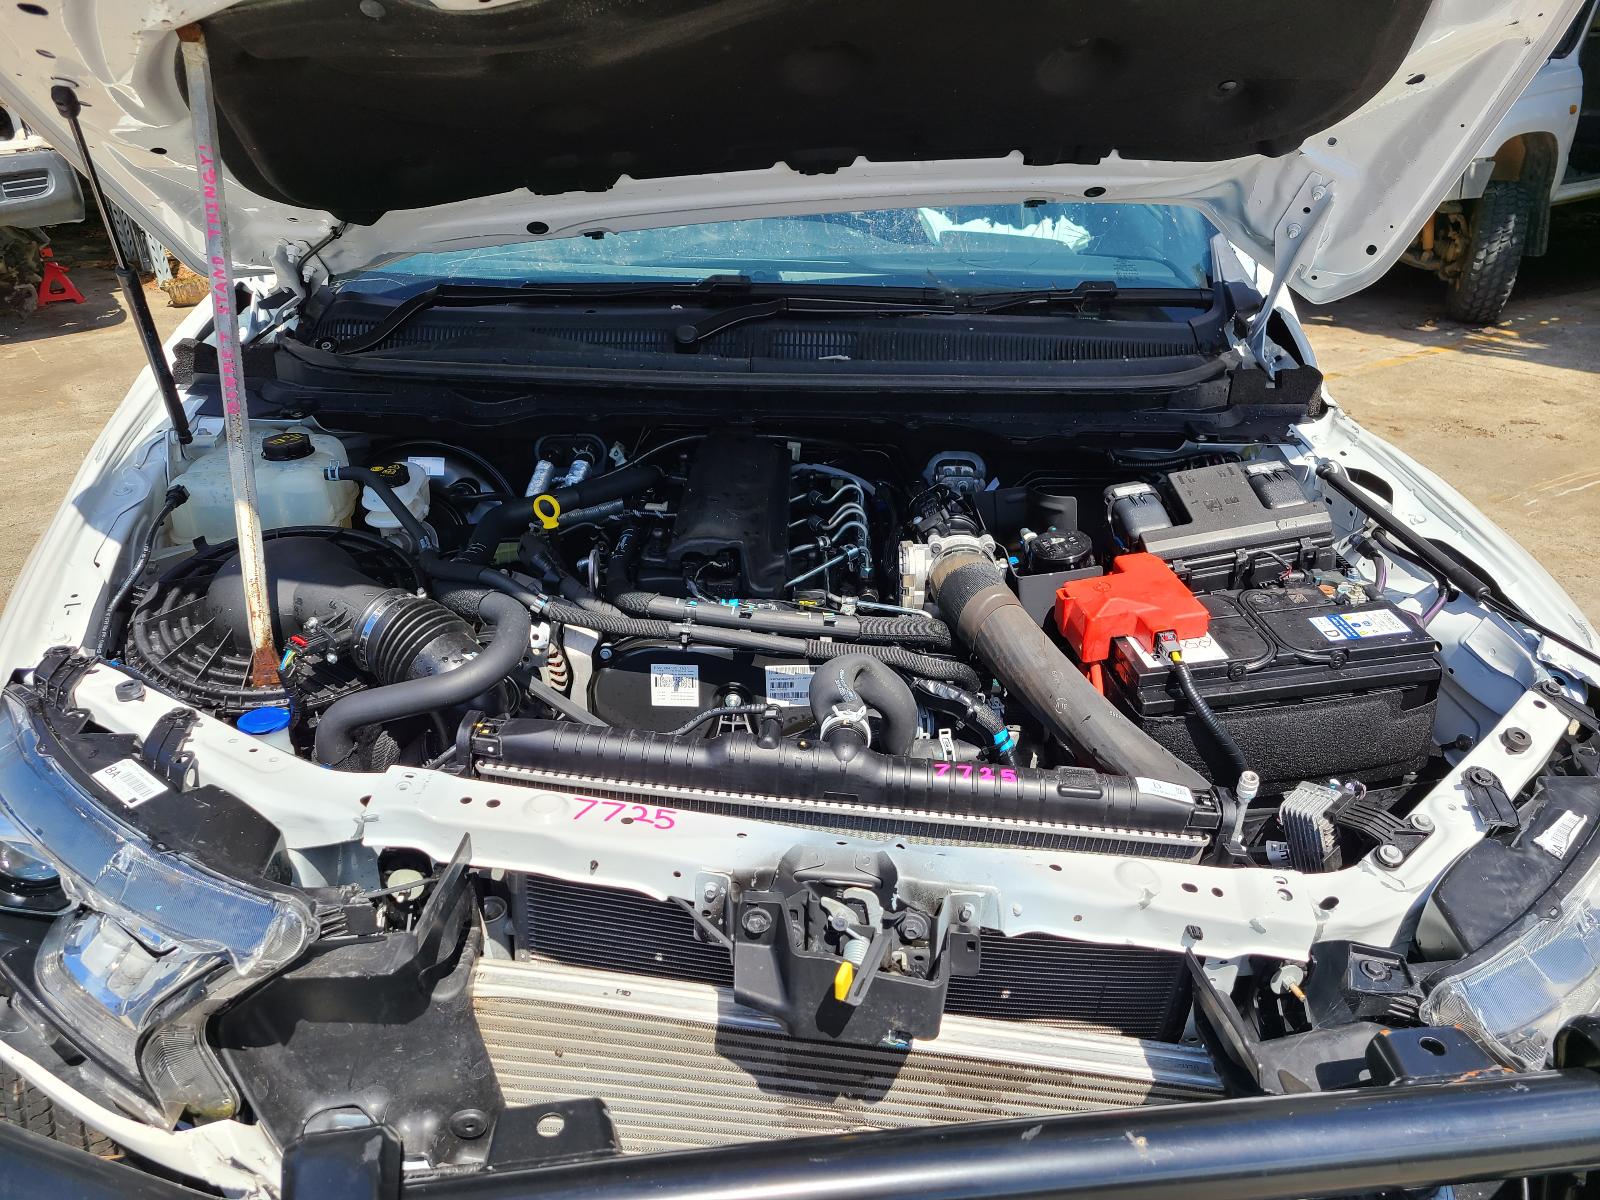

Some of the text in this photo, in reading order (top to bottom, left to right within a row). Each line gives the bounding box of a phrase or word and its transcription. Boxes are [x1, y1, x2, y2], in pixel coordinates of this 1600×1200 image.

[198, 145, 221, 240] THINGY!
[210, 255, 230, 315] STAND
[934, 763, 1018, 783] 7725
[574, 797, 677, 829] 7725
